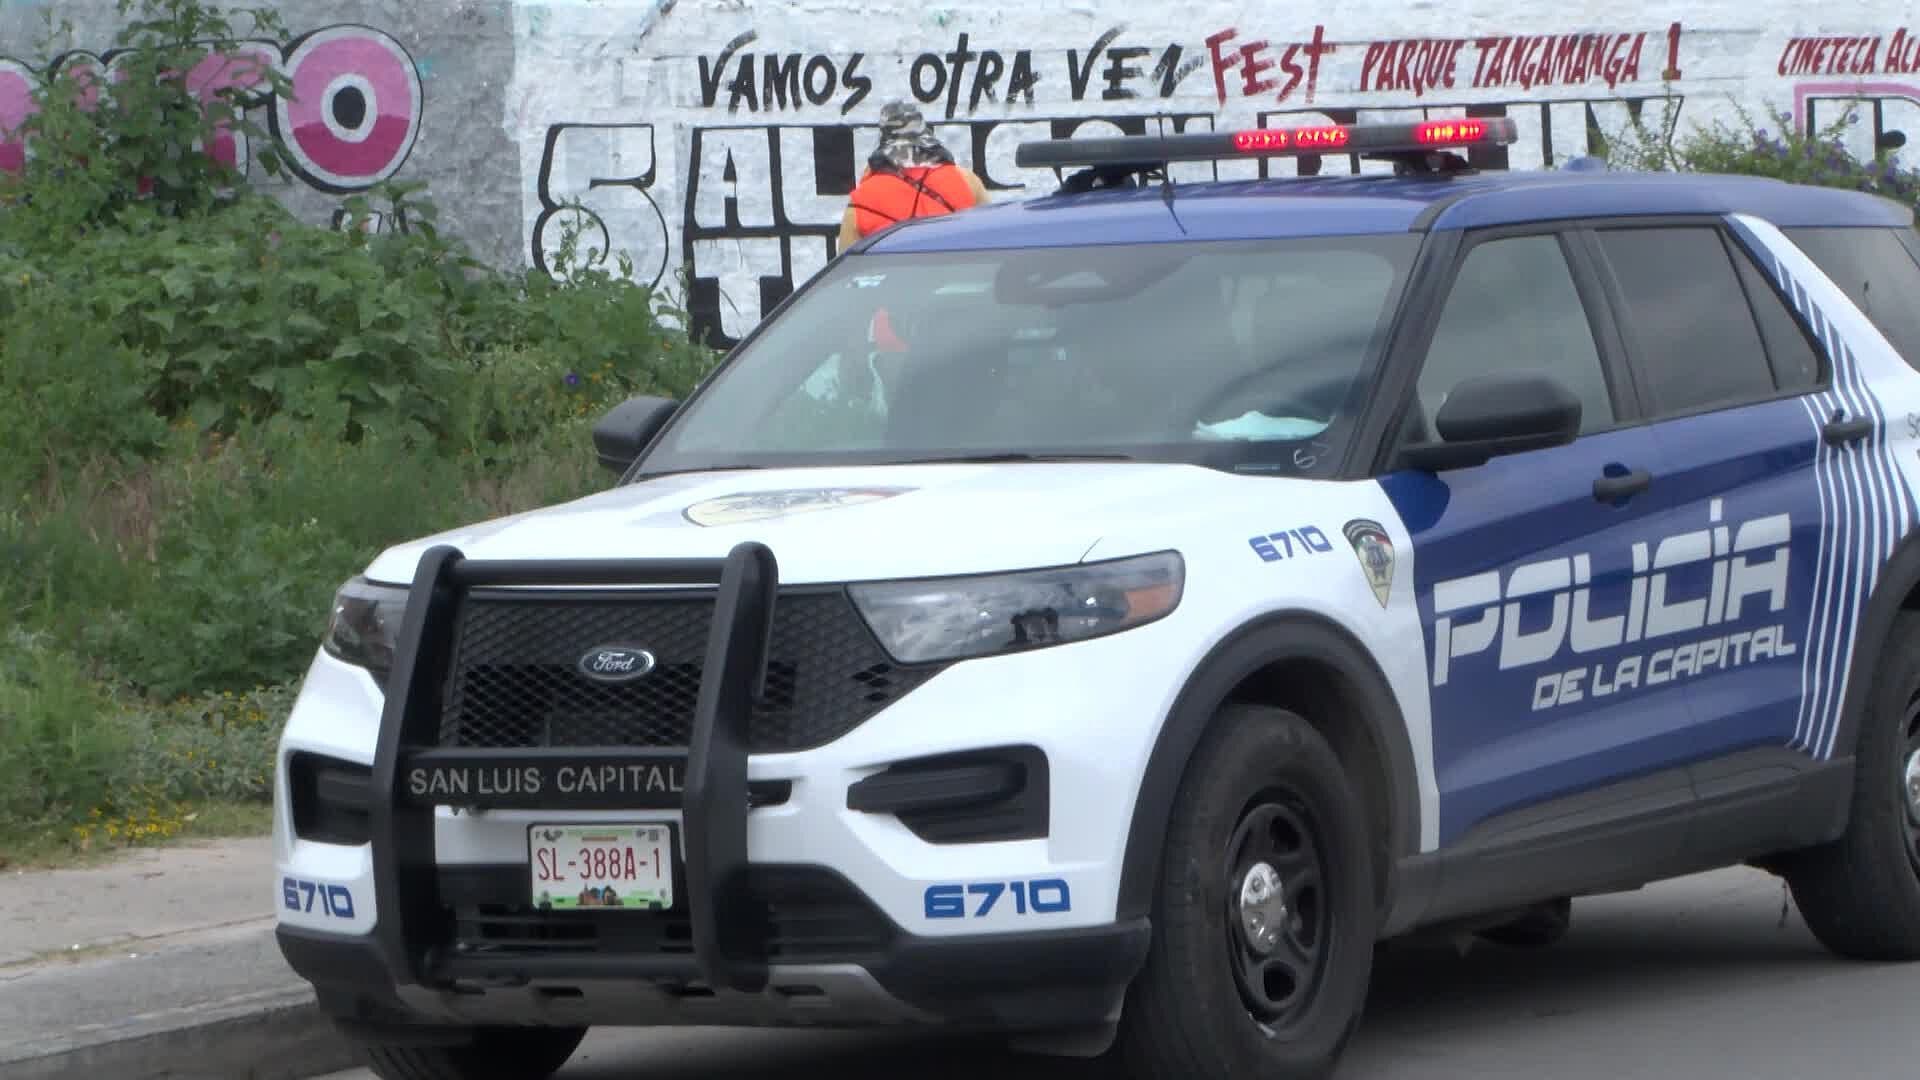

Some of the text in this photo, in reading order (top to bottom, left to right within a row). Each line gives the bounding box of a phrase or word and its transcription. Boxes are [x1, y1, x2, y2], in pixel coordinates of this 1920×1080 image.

[698, 30, 873, 115] VAMOS
[1360, 39, 1465, 96] PARQUE
[1472, 31, 1647, 90] TANGAMANGA
[1662, 22, 1682, 81] 1
[1778, 37, 1881, 76] CINETECA
[1248, 526, 1332, 563] 6710
[593, 652, 635, 673] Ford
[1531, 624, 1796, 712] DE LA CAPITAL
[410, 764, 683, 795] SAN LUIS CAPITAL
[537, 847, 660, 881] SL-388A-1
[284, 877, 354, 918] 6710
[924, 878, 1071, 918] 6710
